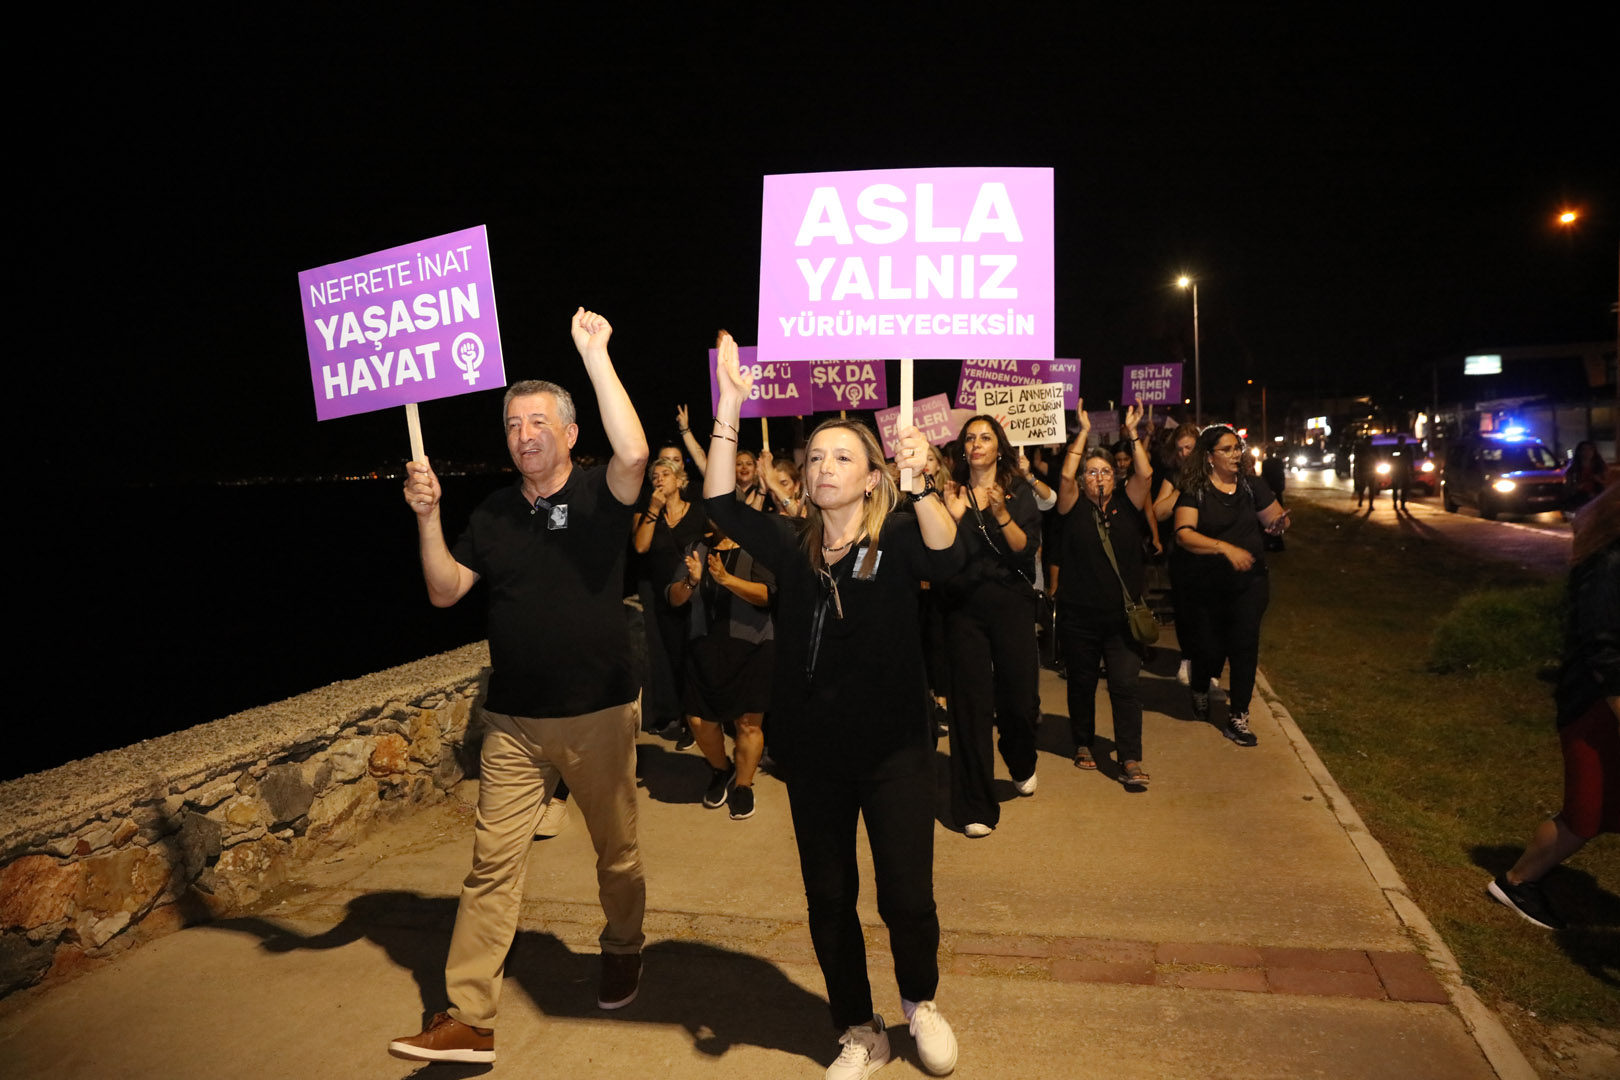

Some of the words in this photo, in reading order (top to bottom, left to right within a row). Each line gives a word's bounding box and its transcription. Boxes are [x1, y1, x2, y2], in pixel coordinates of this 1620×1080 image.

[794, 182, 1024, 246] ASLA
[310, 261, 412, 307] NEFRETE
[417, 246, 472, 282] İNAT
[796, 254, 1018, 301] YALNIZ
[314, 283, 480, 350] YAŞASIN
[779, 308, 1034, 337] YÜRÜMEYECEKSİN
[322, 342, 440, 400] HAYAT
[740, 363, 791, 380] 284'ü
[811, 366, 842, 388] ŞK
[845, 364, 876, 382] DA
[964, 367, 1010, 382] YERİNDEN
[1130, 365, 1173, 380] EŞİTLİK
[749, 383, 799, 400] GULA
[984, 389, 1013, 406] BİZİ
[1019, 386, 1063, 402] ANNEMİZ
[1131, 379, 1171, 390] HEMEN
